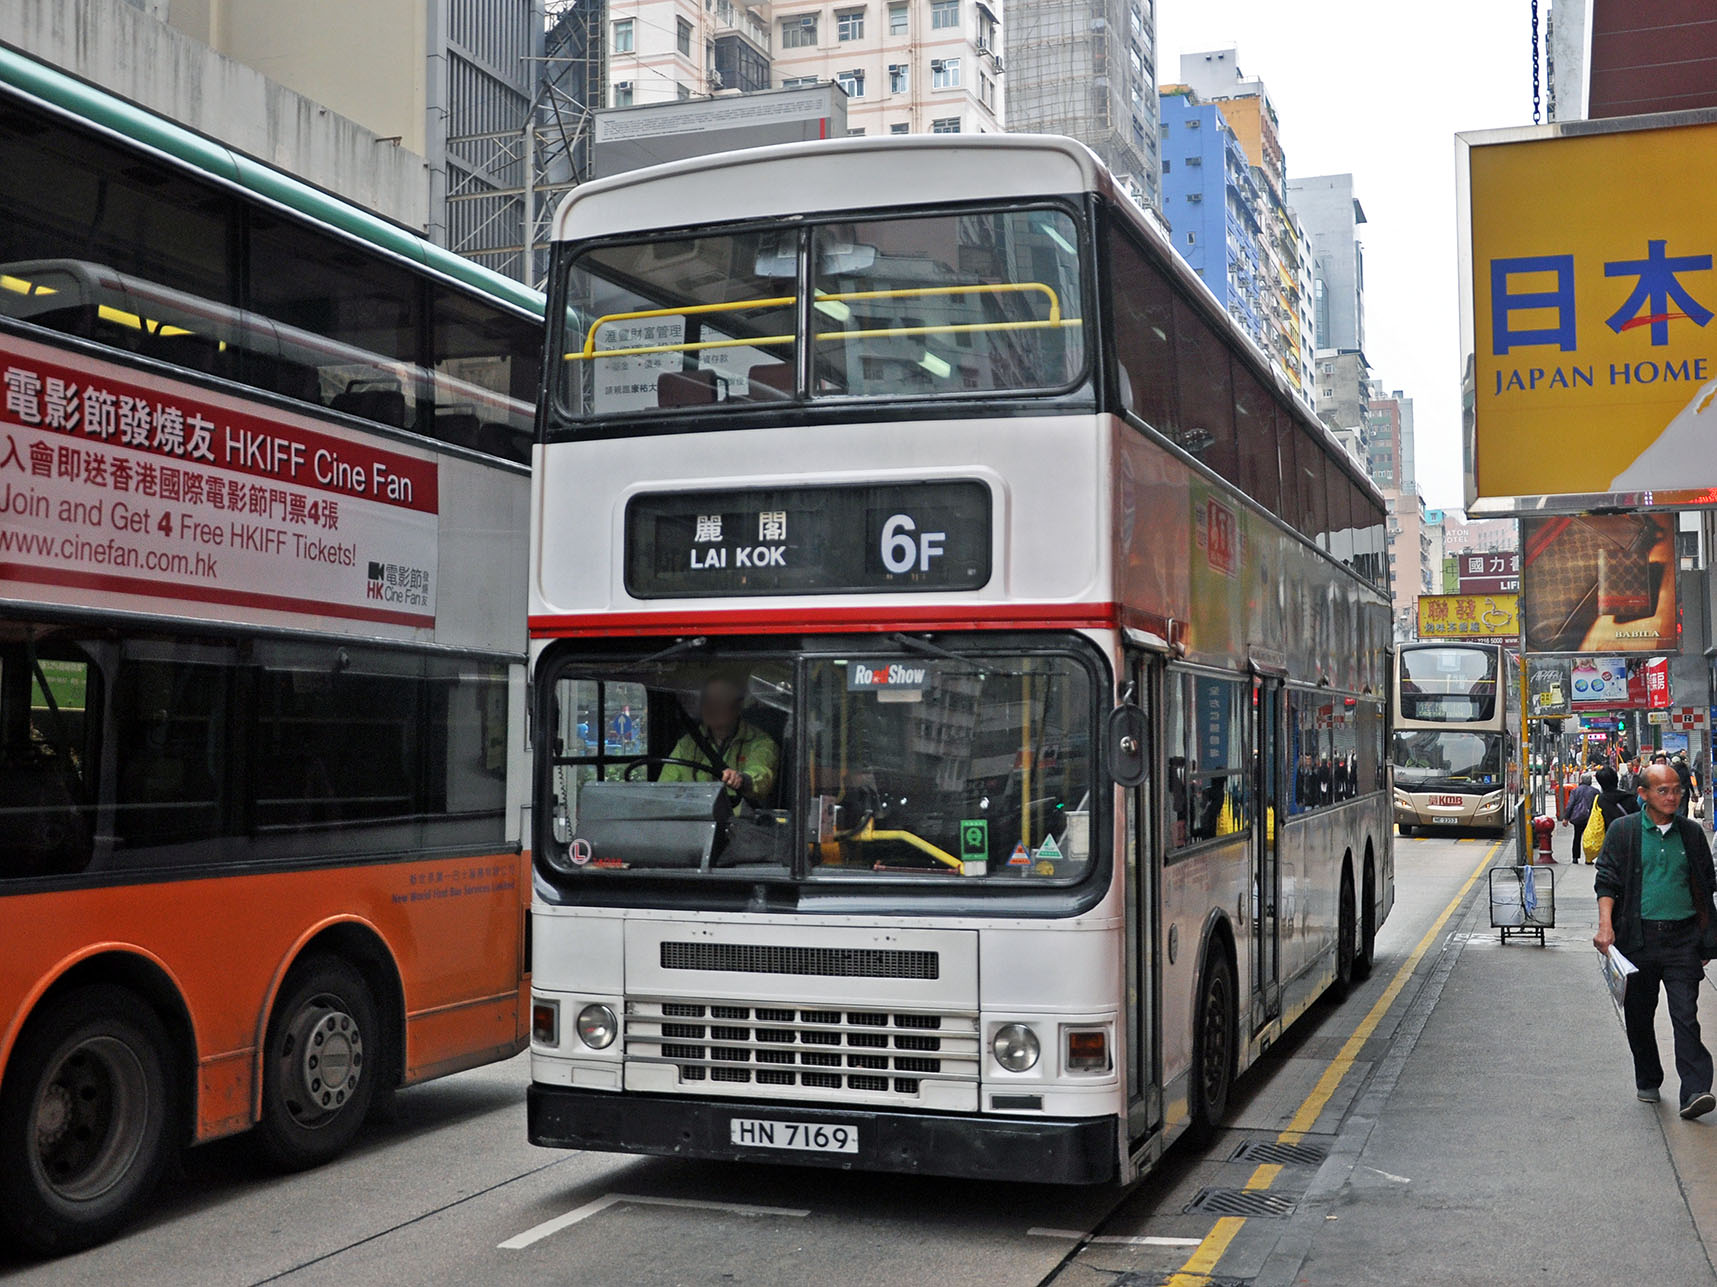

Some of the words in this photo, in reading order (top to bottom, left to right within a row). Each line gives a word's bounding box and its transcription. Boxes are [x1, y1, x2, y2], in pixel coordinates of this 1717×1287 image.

[1490, 239, 1715, 355] 日本
[1495, 365, 1594, 396] JAPAN
[1609, 358, 1708, 385] HOME
[4, 366, 216, 462] 電影節發燒友
[226, 426, 305, 476] HKIFF
[314, 449, 366, 492] Cine
[373, 462, 413, 502] Fan
[0, 483, 49, 518] Join
[58, 499, 102, 527] and
[111, 501, 151, 534] Get
[157, 511, 172, 537] 4
[180, 513, 224, 545] Free
[230, 522, 288, 553] HKIFF
[293, 532, 356, 567] Tickets!
[694, 511, 787, 542] 麗閣
[880, 514, 946, 573] 6F
[0, 530, 218, 578] www.cinefan.com.hk
[690, 548, 726, 569] LAI
[736, 546, 786, 567] KOK
[367, 581, 384, 600] HK
[405, 589, 421, 606] Fan
[1684, 714, 1693, 723] R
[740, 1121, 774, 1144] HN
[785, 1124, 848, 1149] 7169
